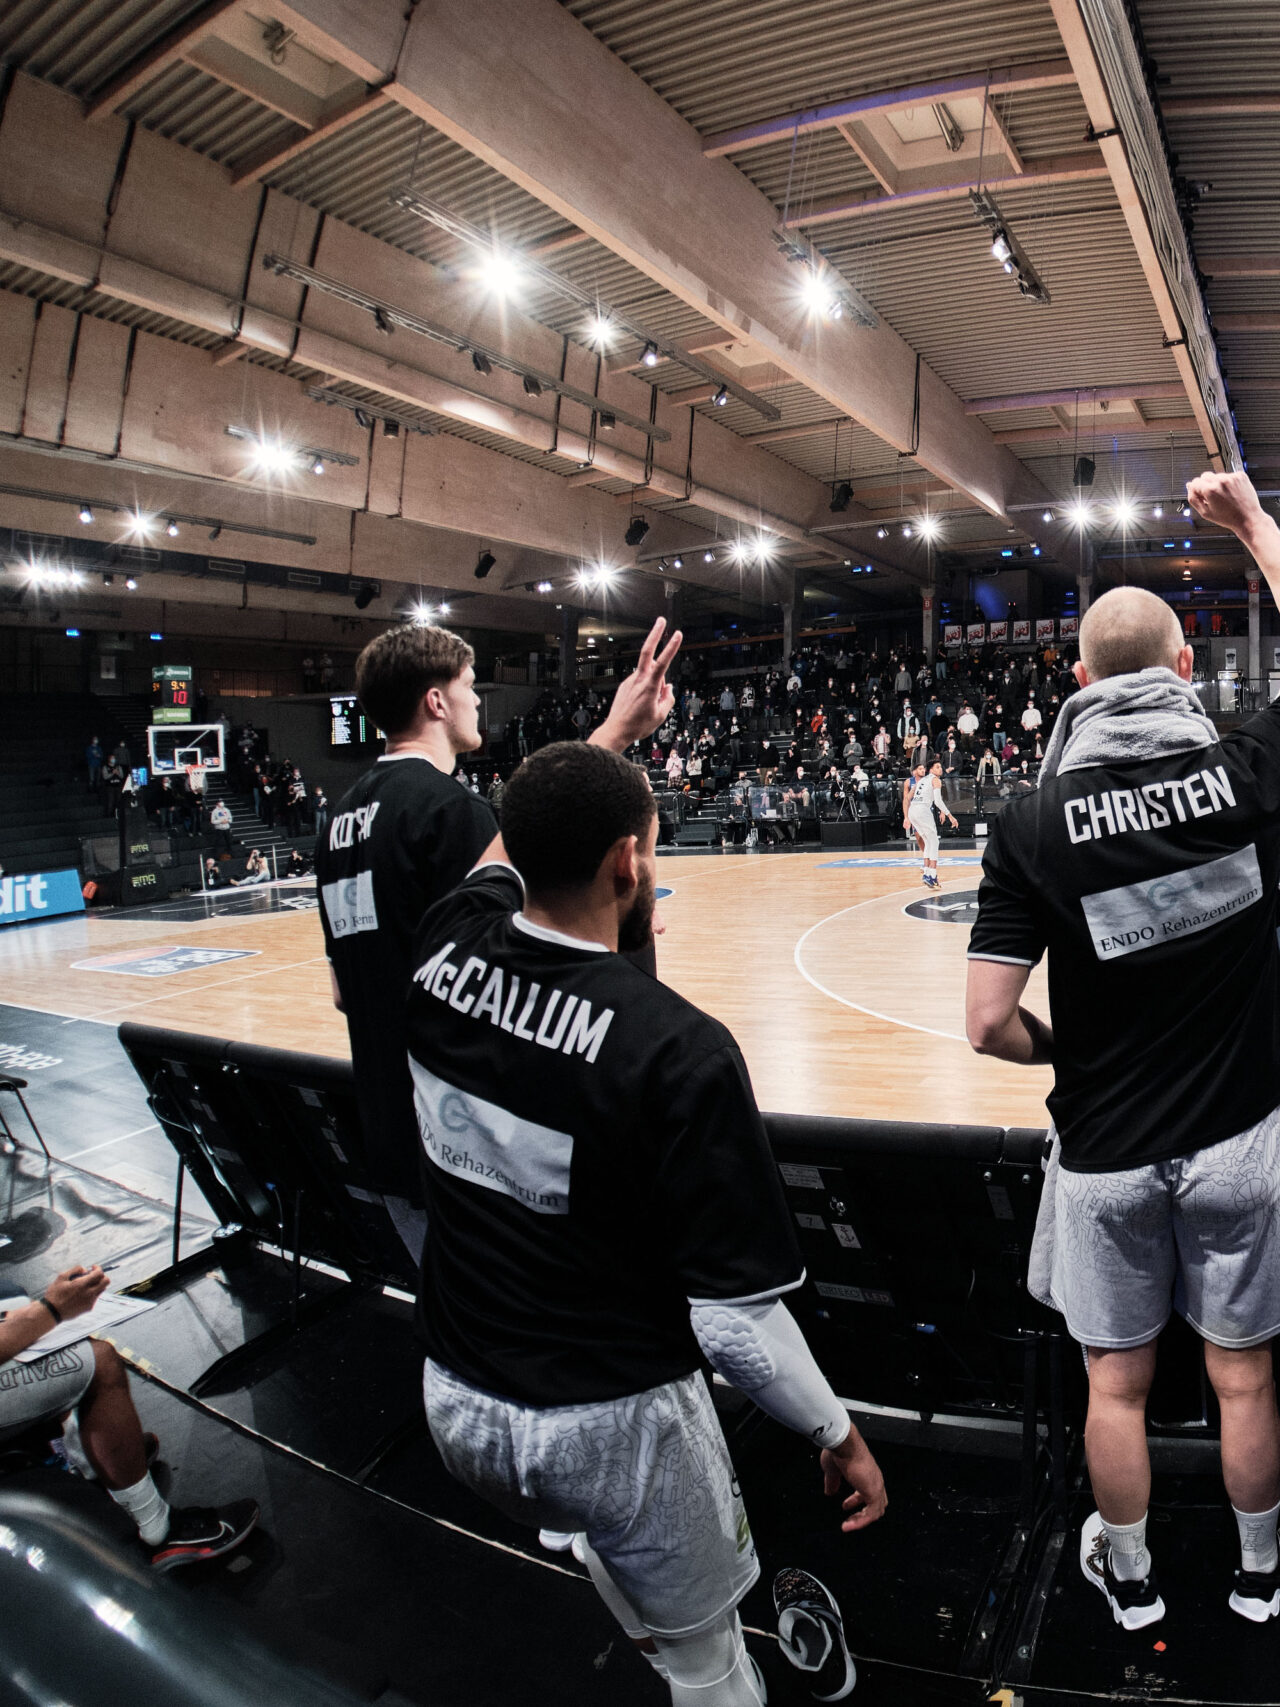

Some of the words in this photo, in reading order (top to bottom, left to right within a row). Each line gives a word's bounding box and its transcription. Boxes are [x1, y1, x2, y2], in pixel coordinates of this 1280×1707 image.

[173, 691, 188, 704] 10
[1064, 765, 1237, 844] CHRISTEN
[1099, 926, 1155, 953] ENDO
[1162, 887, 1259, 937] Rehazentrum
[413, 942, 615, 1064] McCALLUM
[441, 1144, 560, 1208] Rehazentrum
